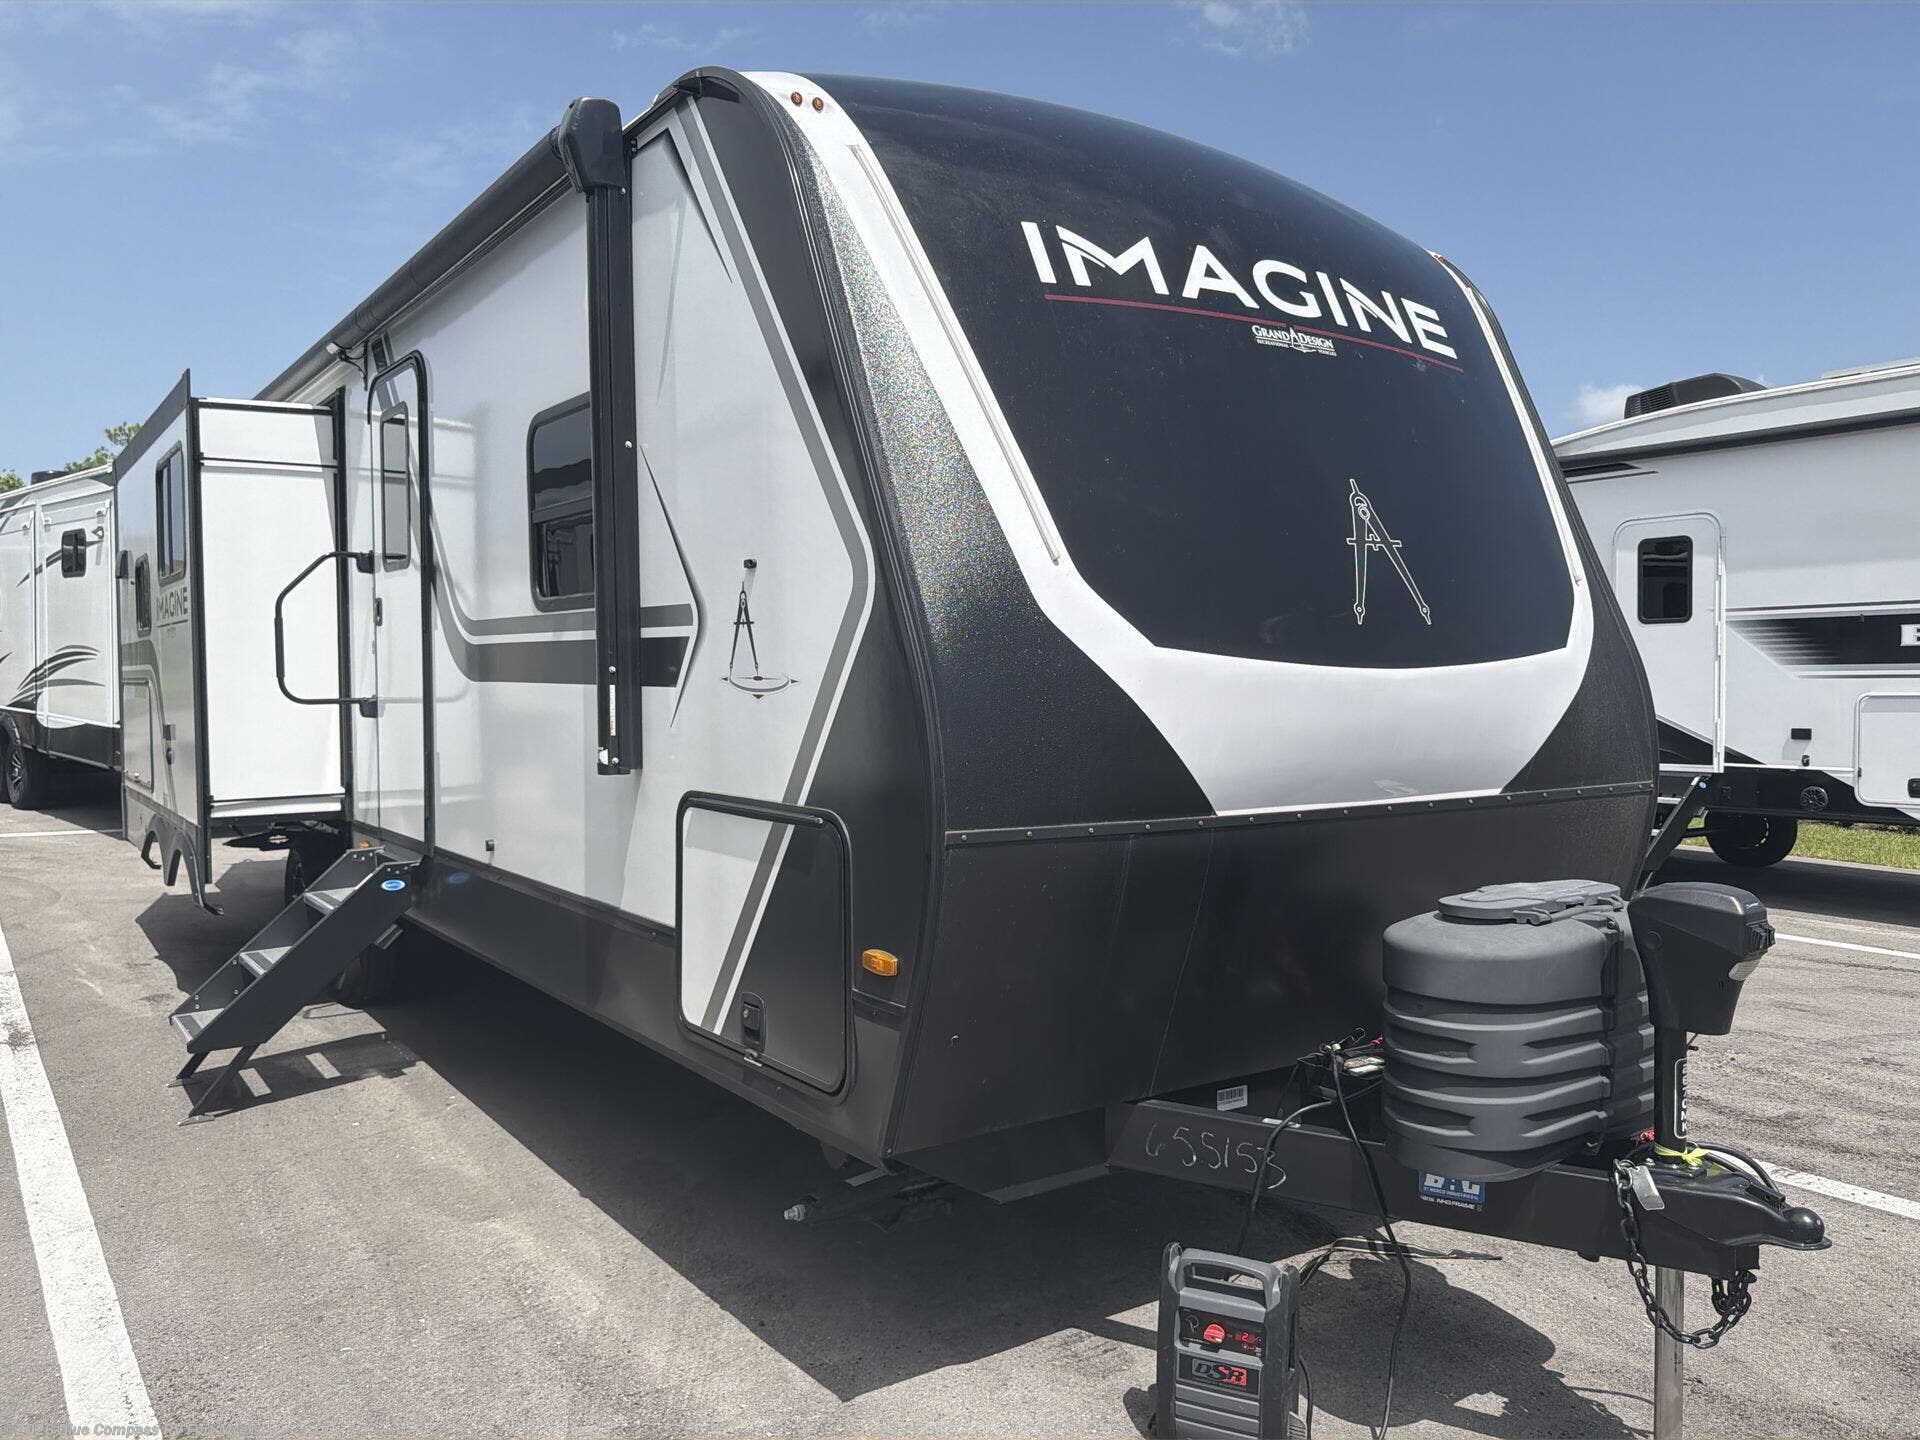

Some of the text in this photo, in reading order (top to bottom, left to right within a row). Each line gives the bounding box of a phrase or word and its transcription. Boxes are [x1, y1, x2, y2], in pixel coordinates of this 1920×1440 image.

[1021, 221, 1458, 359] IMAGINE
[1251, 325, 1335, 349] GRAND DESIGN
[156, 586, 188, 621] IMAGINE
